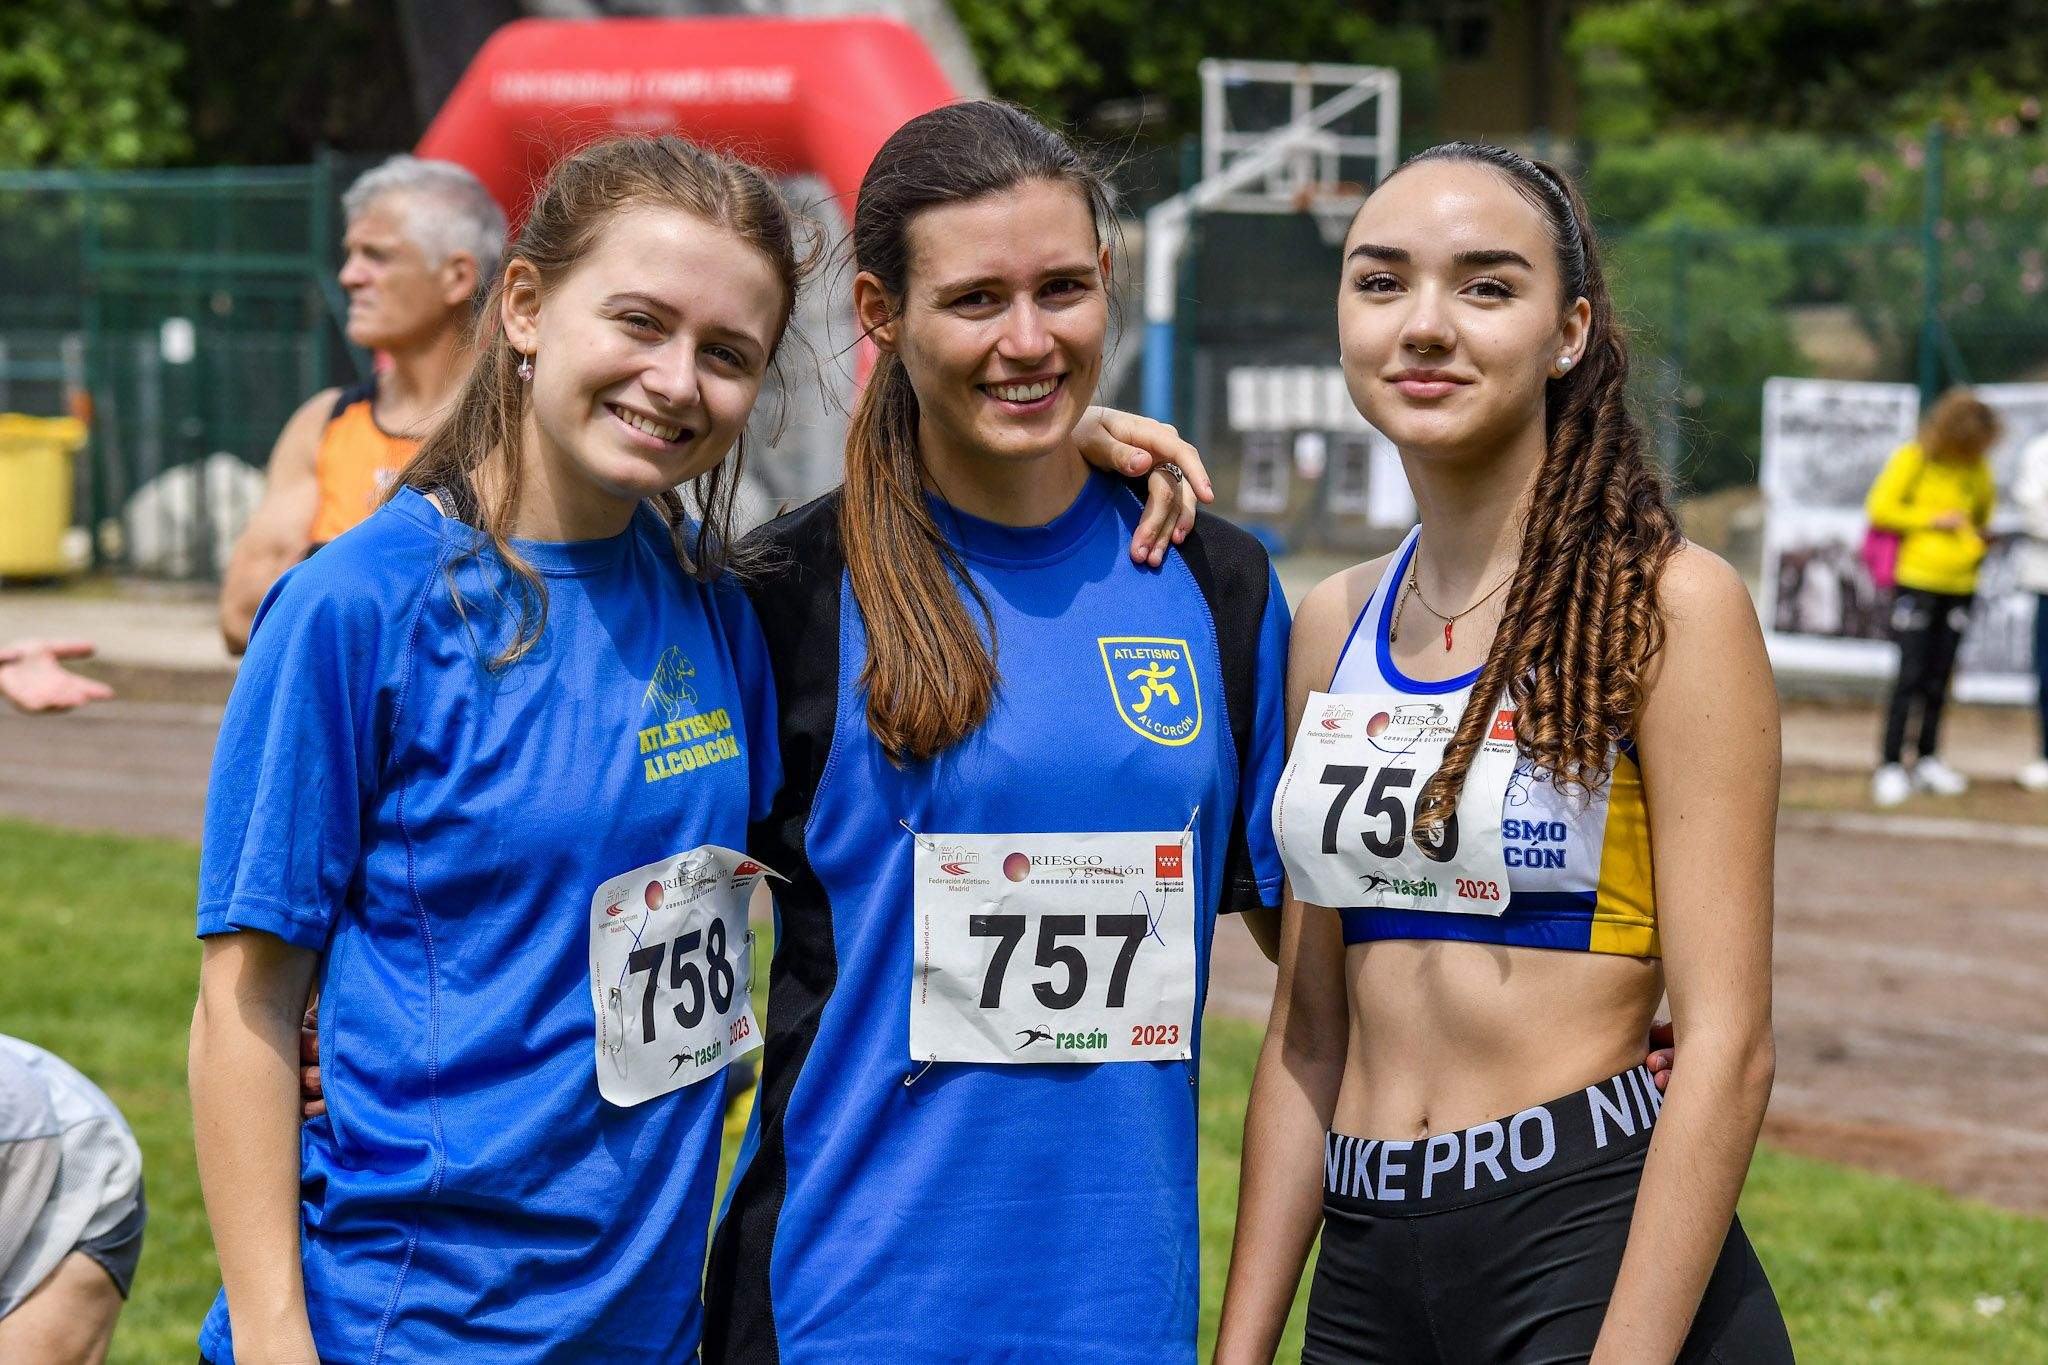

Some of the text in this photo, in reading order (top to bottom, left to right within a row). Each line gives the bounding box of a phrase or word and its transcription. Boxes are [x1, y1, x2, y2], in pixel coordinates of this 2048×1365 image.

[1114, 648, 1180, 660] ATLETISMO
[637, 708, 731, 755] ATLETISMO
[1137, 714, 1194, 737] ALCORCÓN
[1391, 715, 1448, 726] RIESGO
[643, 732, 740, 784] ALCORCÓN
[1030, 855, 1103, 866] RIESGO
[1068, 864, 1145, 879] y gestión
[663, 867, 708, 891] RIESGO
[928, 876, 991, 885] Federación Atletismo
[948, 885, 970, 893] Madrid
[1392, 876, 1438, 898] rasán
[1456, 878, 1500, 901] 2023
[969, 914, 1149, 1011] 757
[628, 916, 735, 1045] 758
[729, 1015, 750, 1047] 2023
[1056, 1027, 1108, 1050] rasán
[1131, 1025, 1179, 1046] 2023
[694, 1036, 722, 1068] rasán
[1322, 1131, 1415, 1201] NIKE
[1421, 1105, 1556, 1199] PRO
